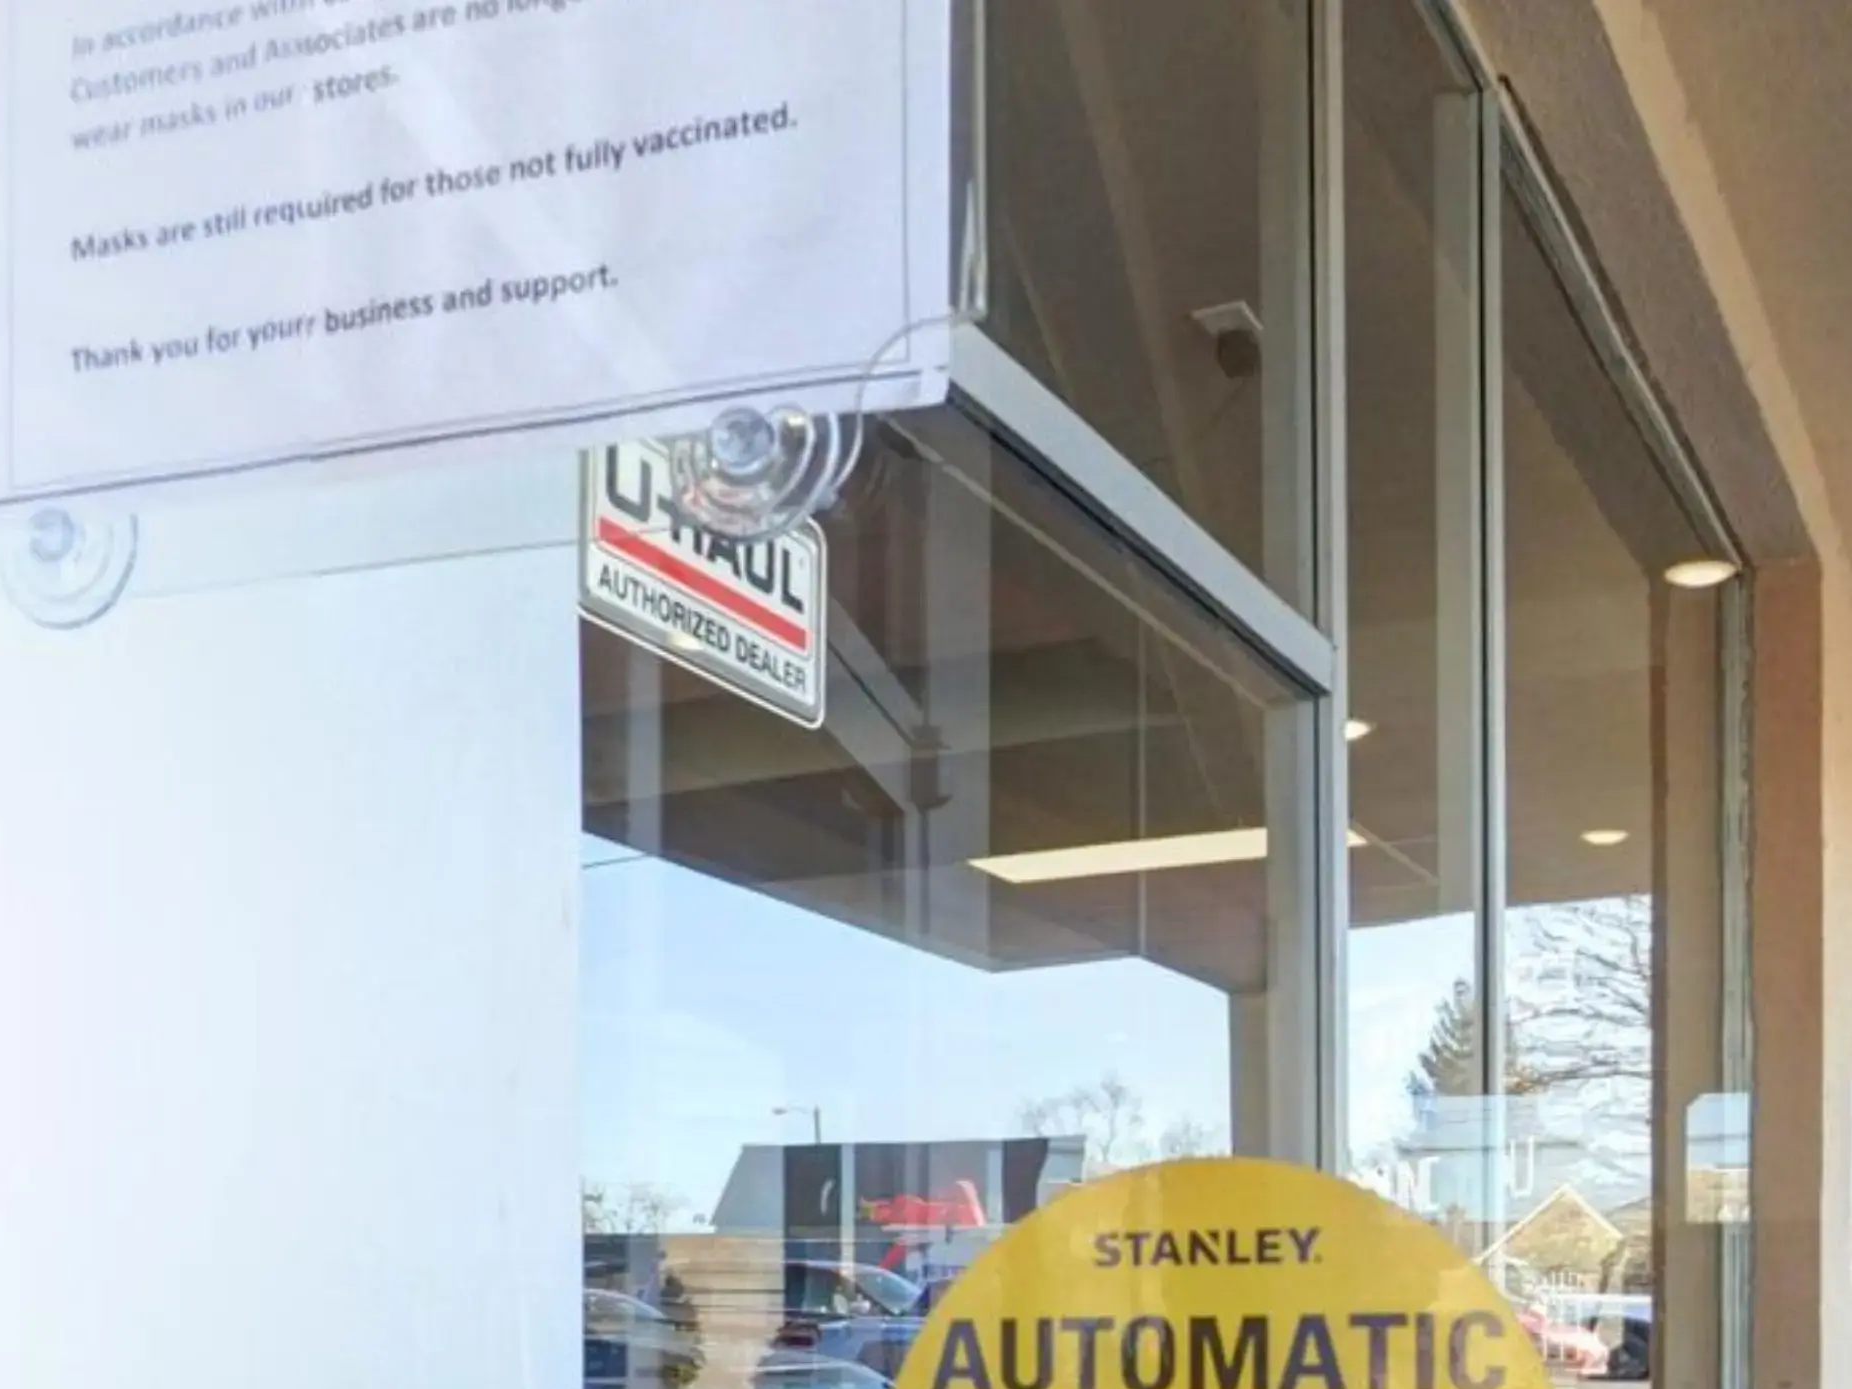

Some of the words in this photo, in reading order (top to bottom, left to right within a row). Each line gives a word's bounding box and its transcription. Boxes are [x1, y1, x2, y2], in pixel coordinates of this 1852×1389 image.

[69, 62, 203, 103] Customers
[210, 42, 257, 78] and
[412, 5, 458, 33] are
[464, 0, 499, 21] no
[72, 120, 132, 150] wear
[139, 100, 217, 138] masks
[224, 96, 248, 121] in
[254, 86, 294, 112] our
[313, 64, 401, 103] stores.
[70, 228, 149, 262] Masks
[156, 220, 197, 248] are
[203, 207, 247, 239] still
[379, 174, 418, 206] for
[425, 163, 501, 198] those
[509, 151, 556, 182] not
[564, 139, 626, 173] fully
[632, 102, 798, 159] vaccinated.
[71, 338, 143, 373] Thank
[151, 335, 199, 366] you
[205, 323, 242, 356] for
[324, 292, 434, 335] business
[442, 277, 492, 314] and
[501, 263, 618, 304] support.
[599, 563, 730, 653] AUTHORIZED
[736, 635, 807, 694] DEALER
